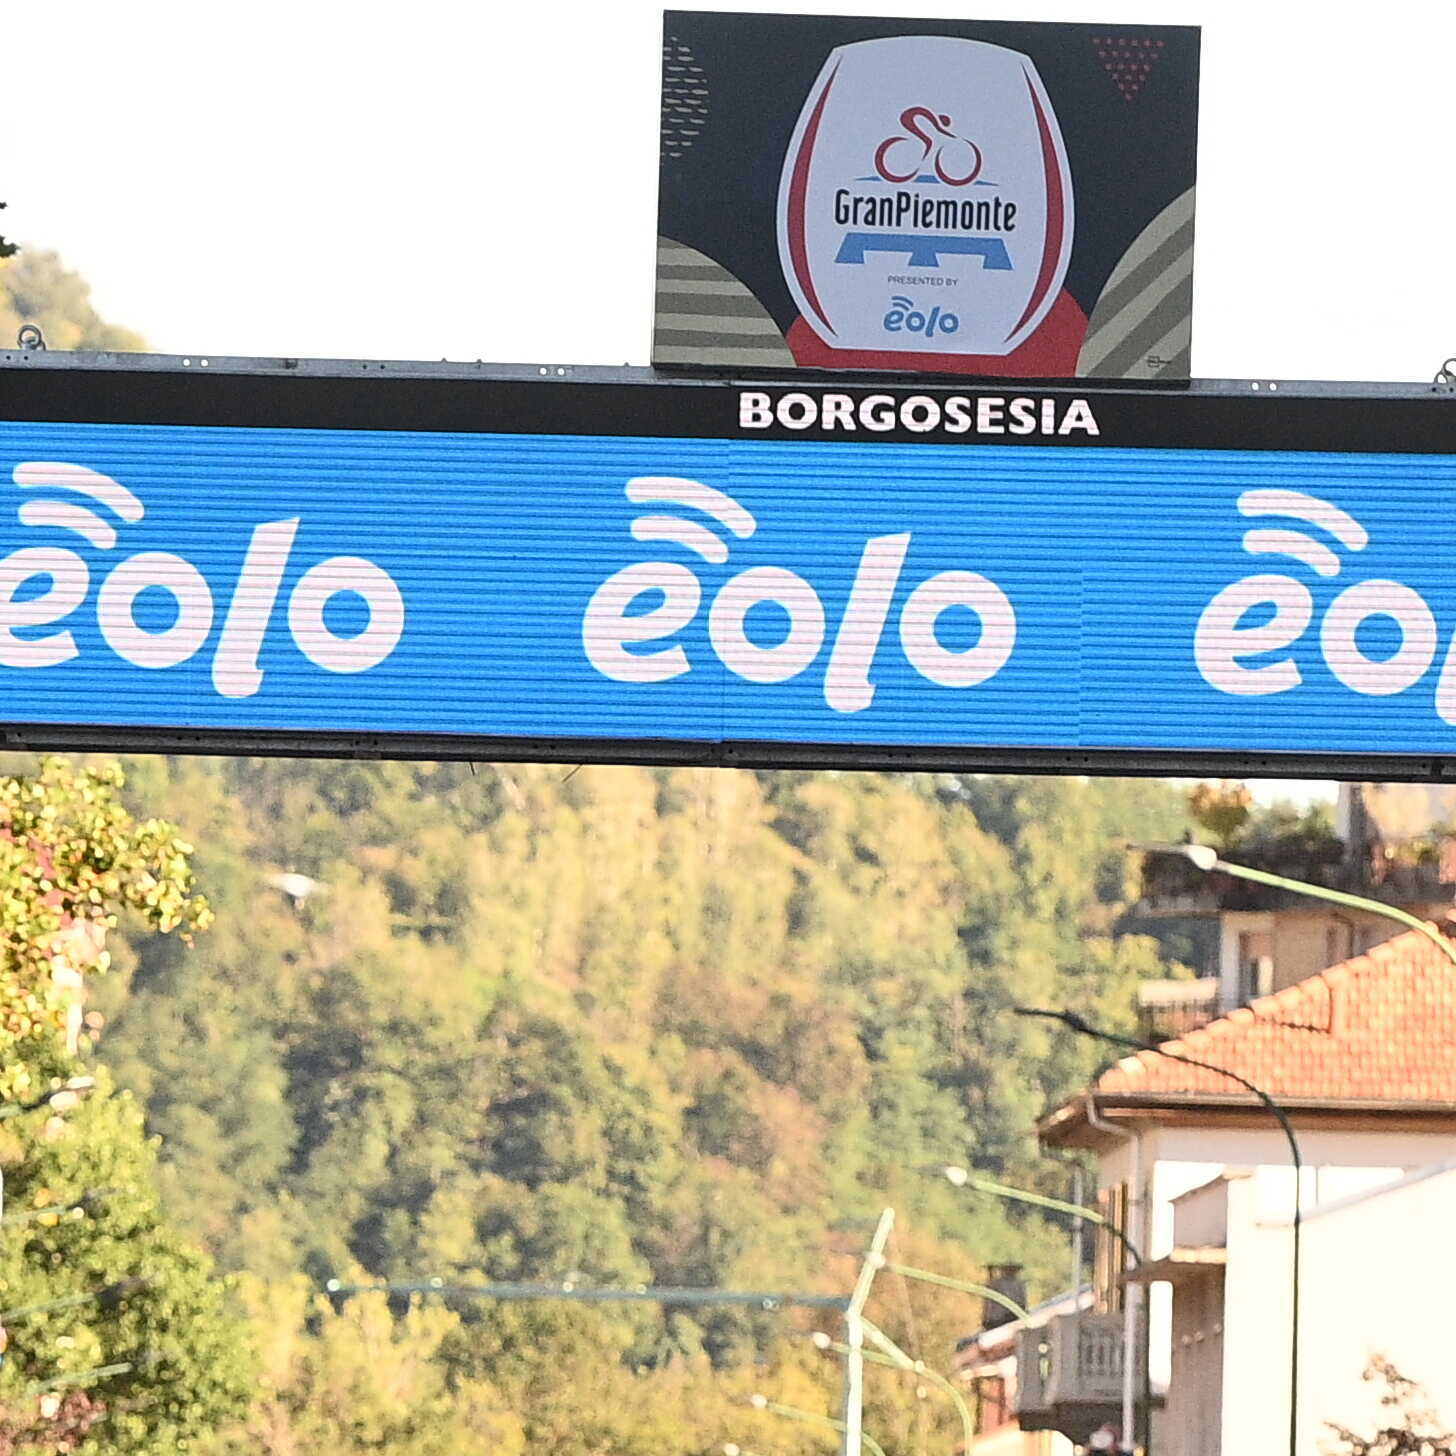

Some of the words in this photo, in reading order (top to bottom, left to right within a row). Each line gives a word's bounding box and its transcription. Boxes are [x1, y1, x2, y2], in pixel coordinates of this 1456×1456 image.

[835, 189, 1017, 233] GranPiemonte
[888, 276, 938, 286] PRESENTED
[941, 277, 958, 286] BY
[883, 302, 959, 337] eolo
[739, 391, 1100, 436] BORGOSESIA
[582, 532, 1017, 712] eolo
